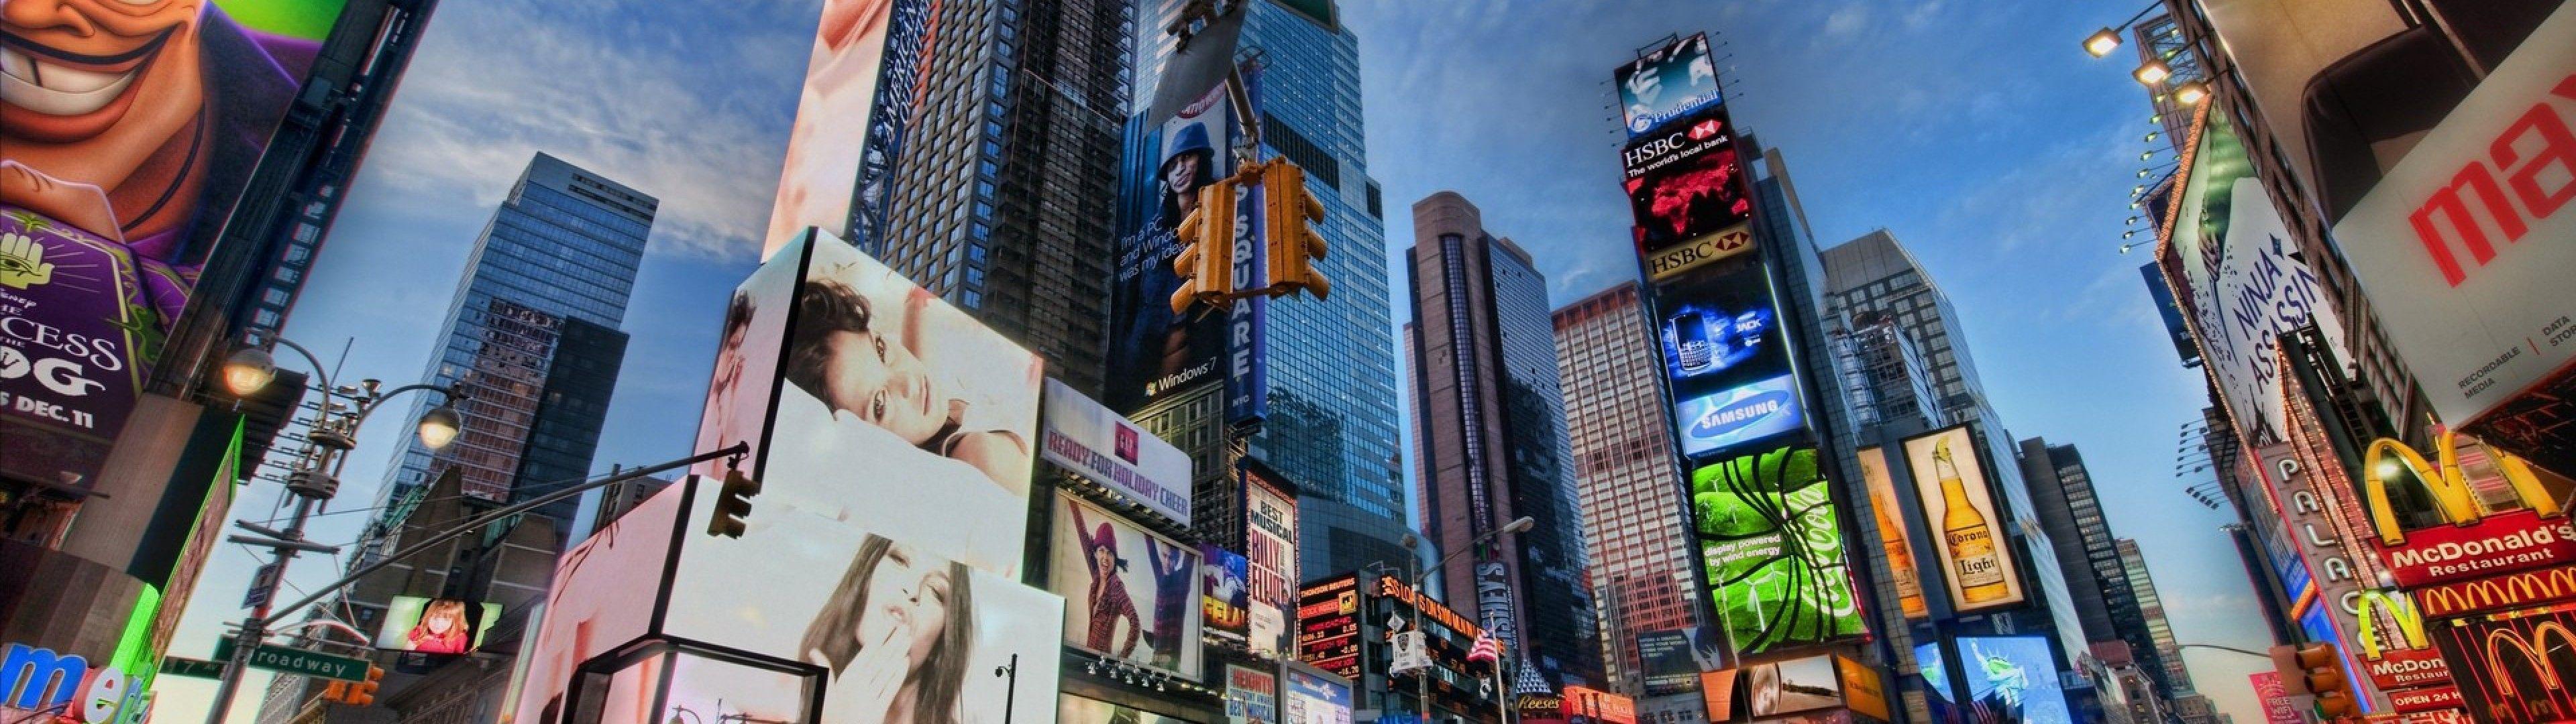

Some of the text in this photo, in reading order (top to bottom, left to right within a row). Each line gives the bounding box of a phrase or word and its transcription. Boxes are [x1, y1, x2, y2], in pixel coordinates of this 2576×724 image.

[1654, 88, 1719, 123] Prudential
[1625, 131, 1685, 167] HSBC
[1627, 135, 1729, 177] The world's local bank
[2408, 74, 2576, 288] ma
[1146, 217, 1163, 237] PC
[1120, 227, 1179, 267] and Windo
[1651, 241, 1714, 274] HSBC
[1120, 263, 1140, 282] was
[1142, 253, 1160, 272] my
[1231, 215, 1252, 375] SQUARE
[2233, 247, 2283, 341] NINJA
[2542, 316, 2570, 336] DATA
[1159, 356, 1218, 391] Windows 7
[2458, 347, 2521, 389] RECORDABLE
[2464, 377, 2496, 399] MEDIA
[17, 395, 70, 422] DEC.
[72, 410, 93, 428] 11
[1701, 400, 1779, 430] SAMSUNG
[1048, 430, 1188, 517] READY FOR HOLIDAY CHEER
[1250, 509, 1293, 544] MUSICAL
[1260, 499, 1283, 524] BEST
[1252, 528, 1280, 575] BILLY
[1705, 534, 1782, 557] display powered
[1948, 529, 1989, 546] Corona
[2392, 522, 2576, 568] McDonald's
[1709, 546, 1782, 567] by wind energy
[1958, 557, 1996, 576] Light
[2428, 547, 2554, 577] Restaurant
[256, 648, 347, 676] roadway
[2373, 658, 2445, 676] McDon
[2394, 670, 2449, 682] Restaur
[2396, 691, 2463, 706] OPEN 24 H
